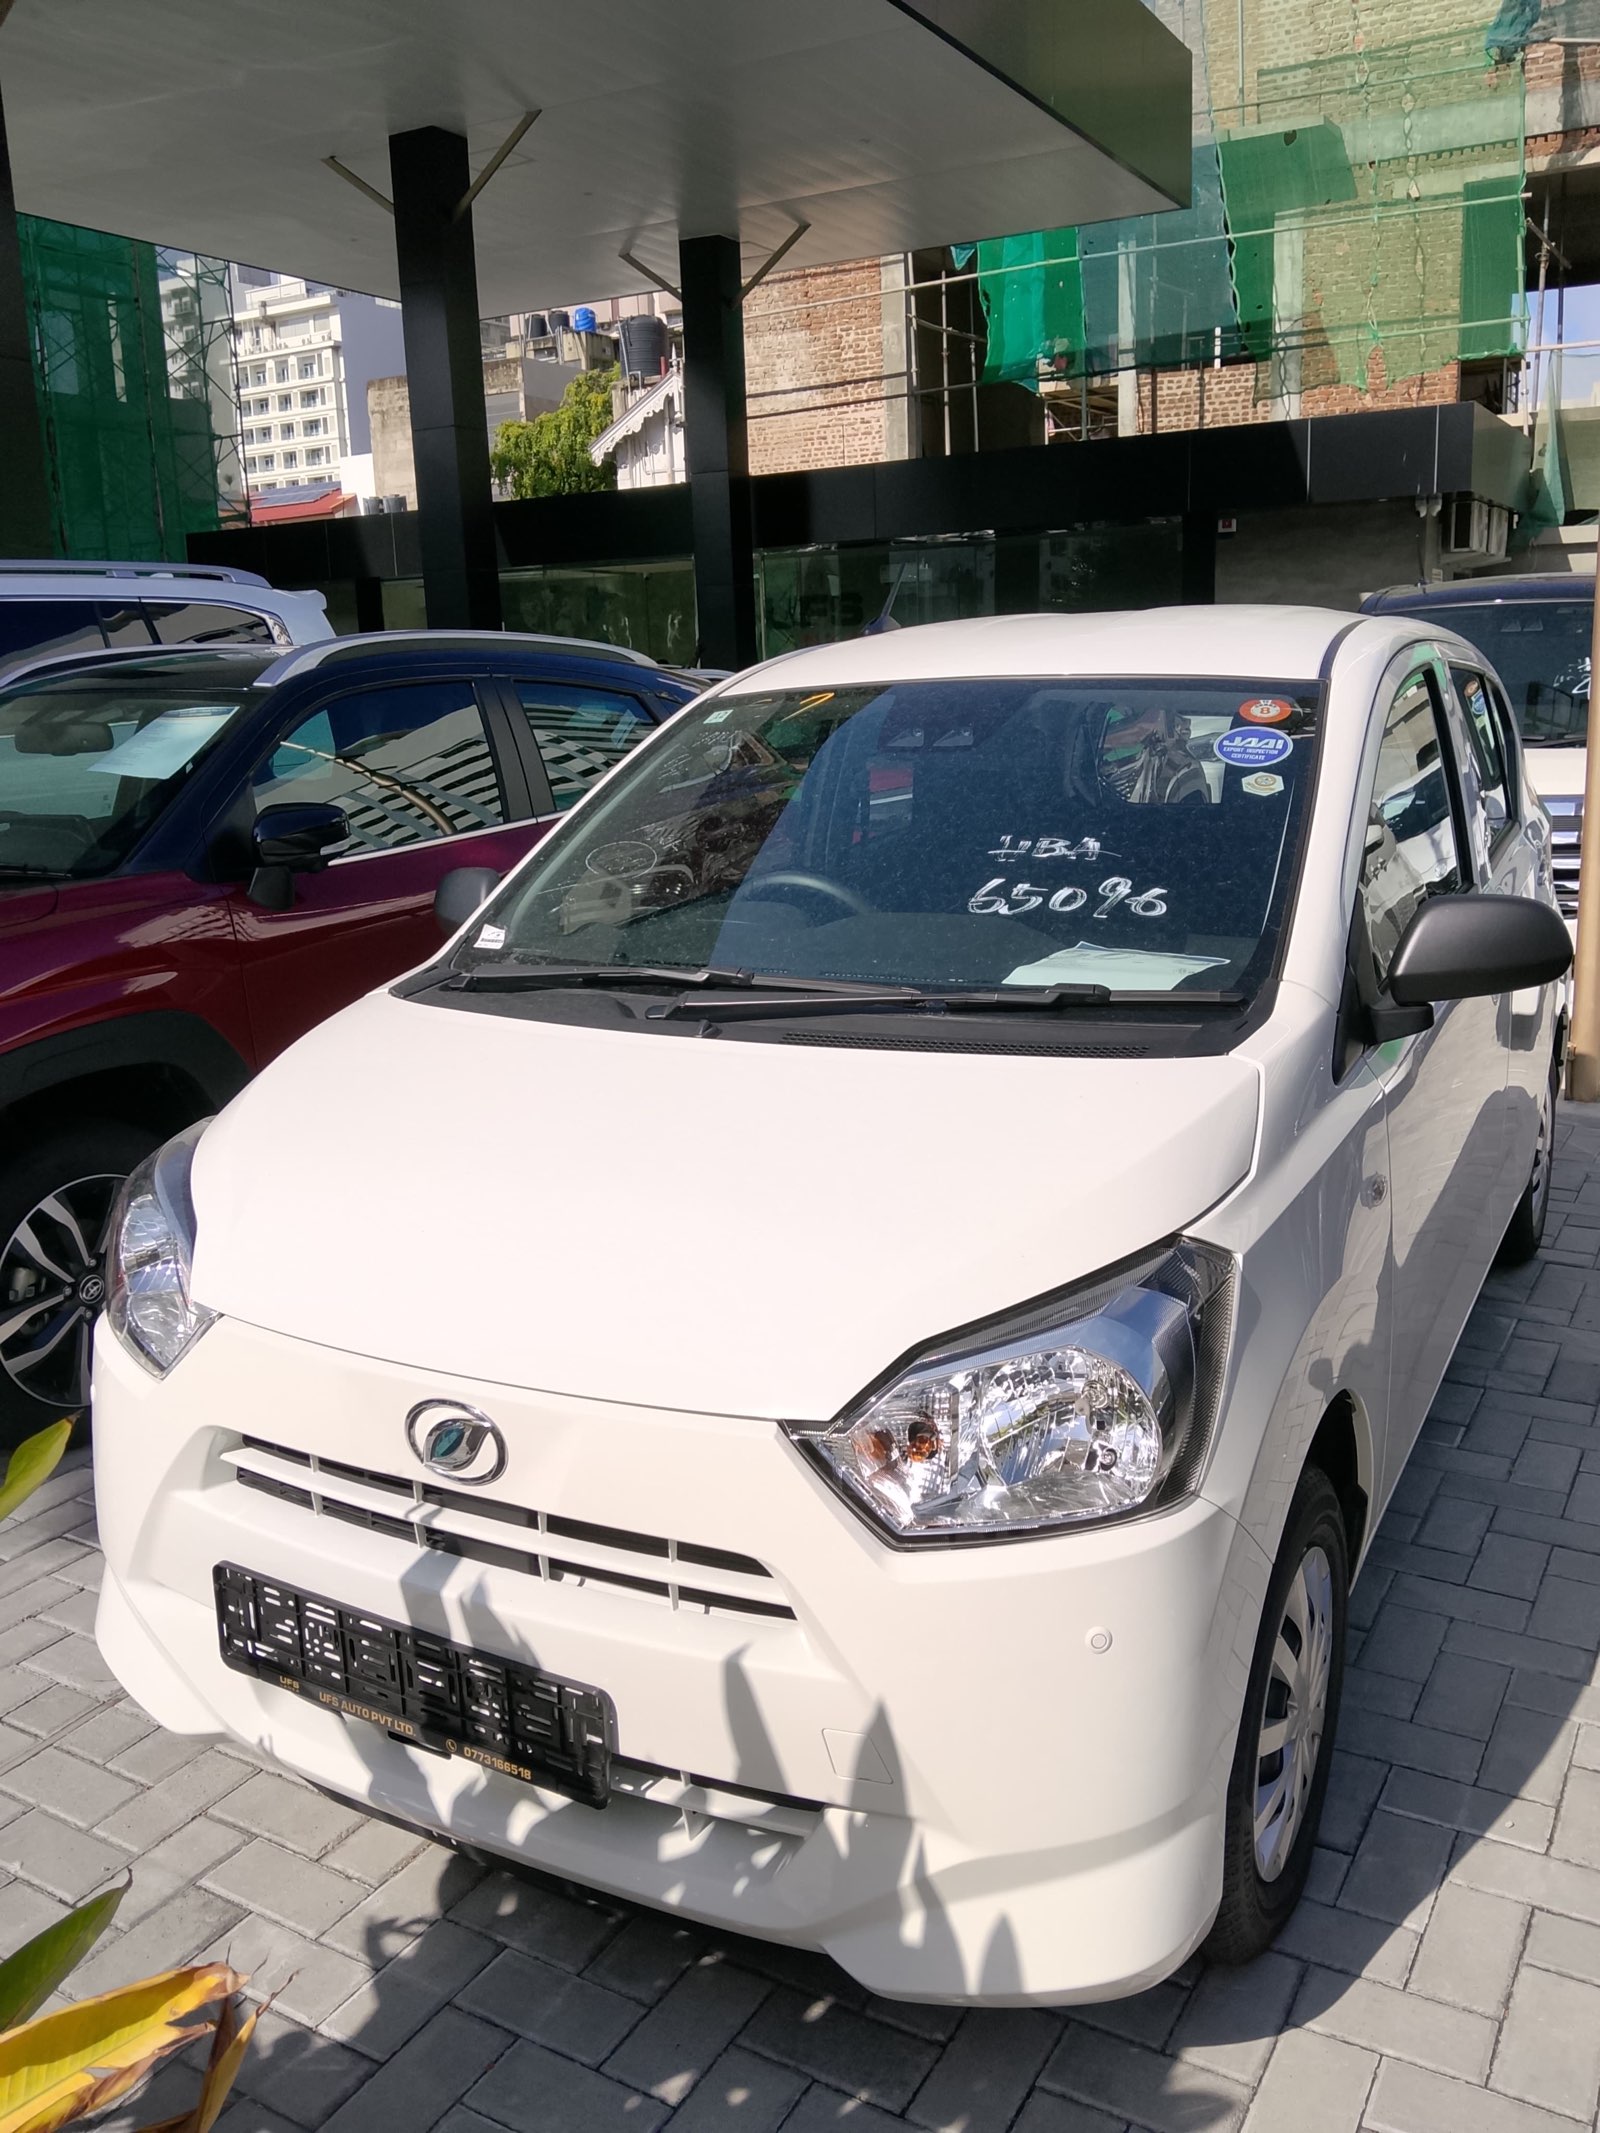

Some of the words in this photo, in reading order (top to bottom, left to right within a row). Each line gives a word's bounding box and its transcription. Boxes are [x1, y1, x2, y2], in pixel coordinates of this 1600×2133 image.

[1260, 706, 1271, 715] 8
[1222, 737, 1284, 750] JAAI
[1231, 752, 1266, 760] CERTIFICATE
[967, 876, 1168, 919] 65096
[319, 1691, 339, 1707] UFS
[341, 1700, 370, 1718] AUTO
[371, 1711, 393, 1728] PVT
[394, 1719, 417, 1737] LTD.
